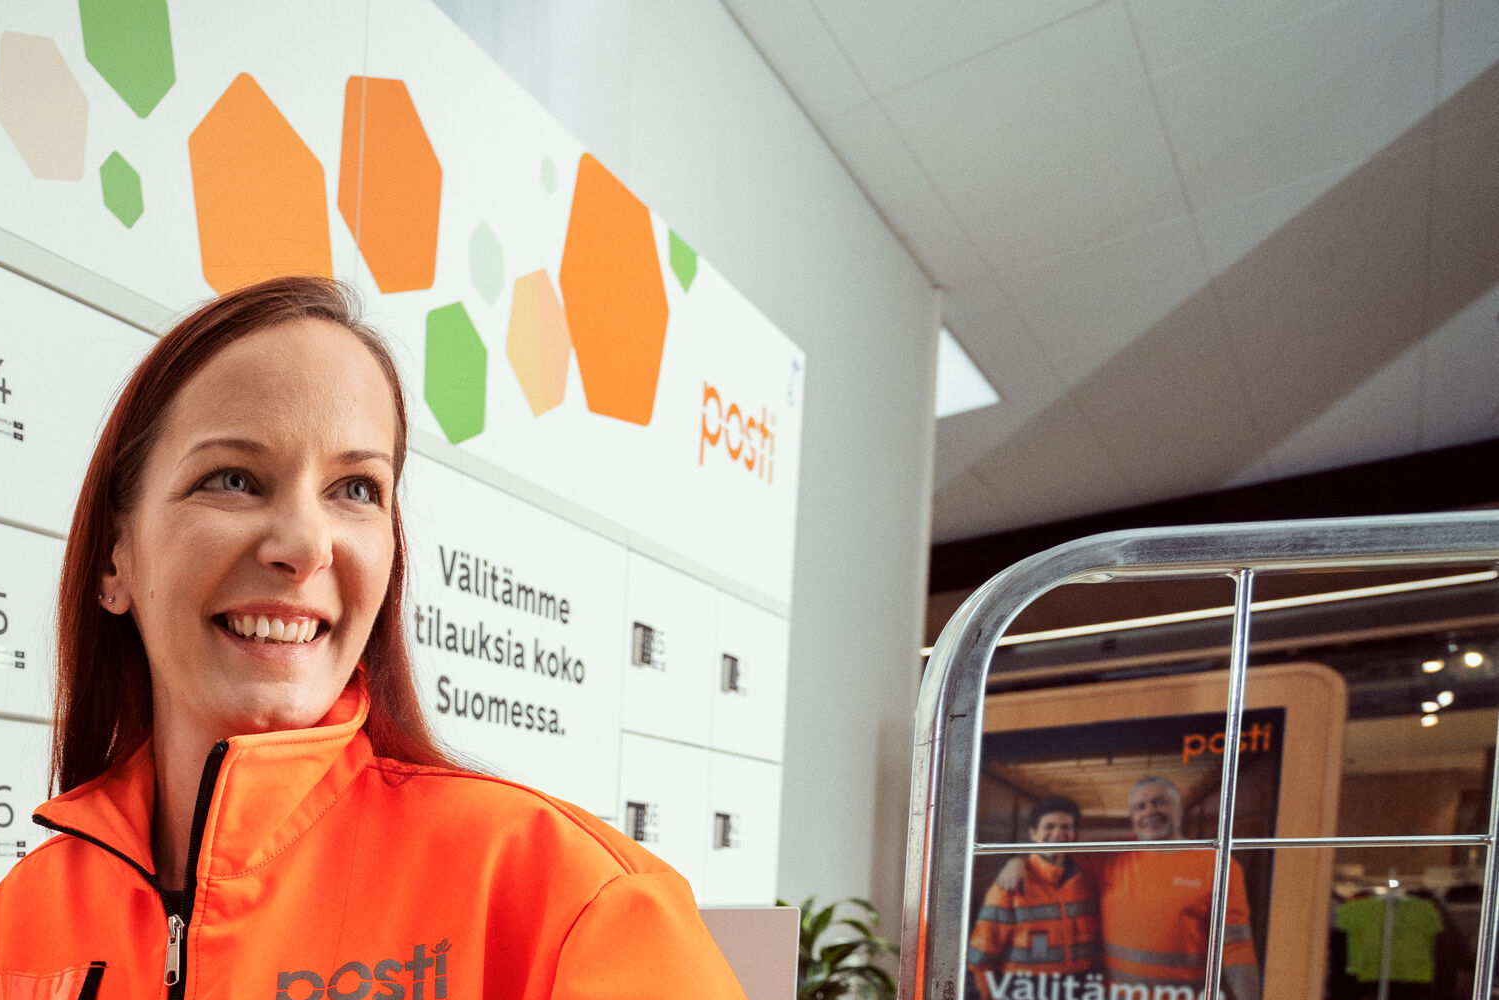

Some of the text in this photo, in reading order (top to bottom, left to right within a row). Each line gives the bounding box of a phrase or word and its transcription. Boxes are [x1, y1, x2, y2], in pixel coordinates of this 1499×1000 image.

[699, 380, 777, 485] posti
[438, 544, 572, 625] Välitämme
[414, 604, 525, 670] tilauksia
[533, 637, 586, 685] koko
[436, 675, 567, 737] Suomessa.
